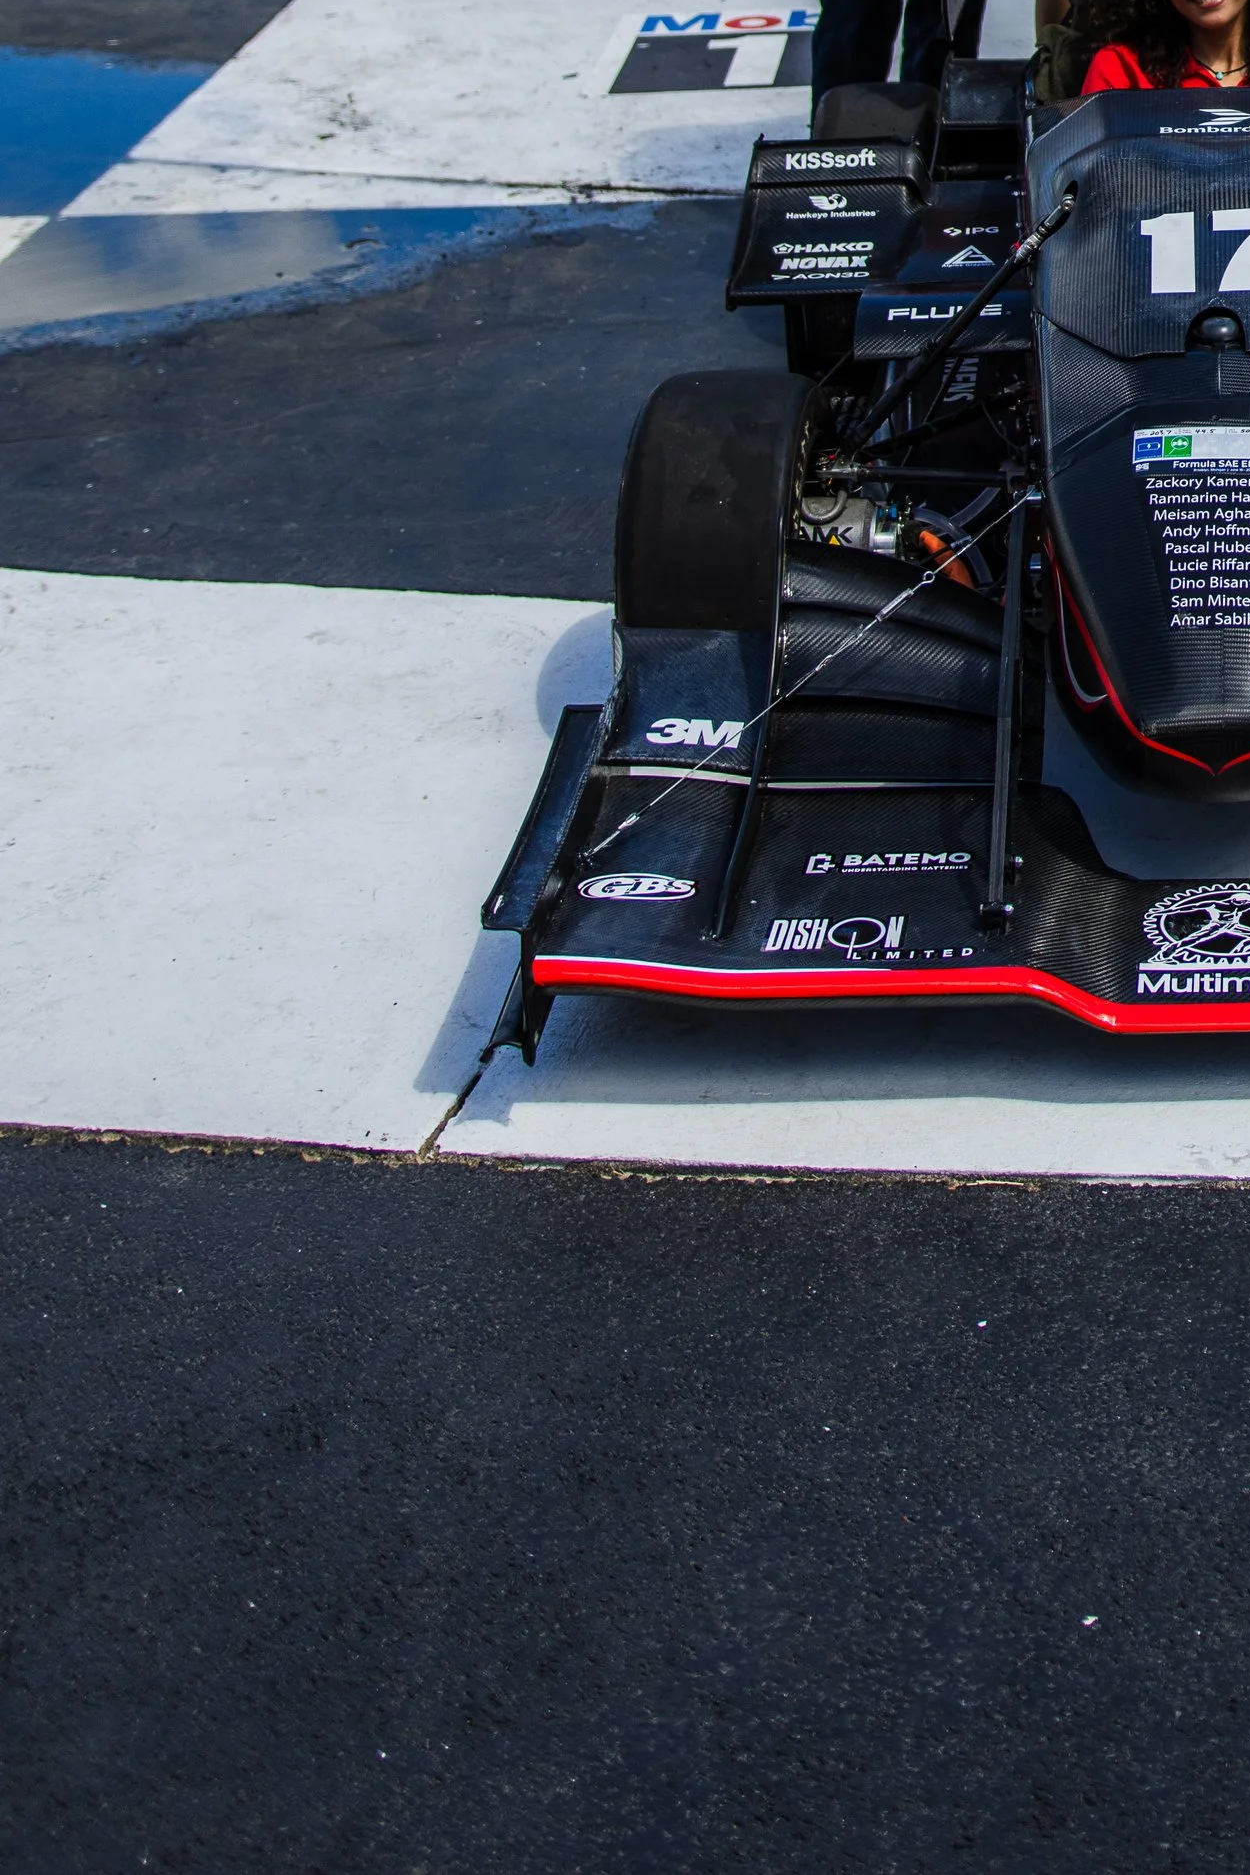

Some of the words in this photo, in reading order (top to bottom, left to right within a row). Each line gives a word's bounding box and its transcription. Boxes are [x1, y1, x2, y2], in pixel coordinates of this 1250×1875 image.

[640, 10, 822, 33] Mob
[785, 148, 876, 170] KISSsoft
[786, 211, 828, 219] Hawkeye
[830, 210, 876, 218] Industries
[965, 226, 999, 235] IPG
[794, 242, 875, 253] HAKKO
[780, 256, 868, 270] NOVAX
[888, 303, 1003, 321] FLUE
[1173, 461, 1216, 469] Formula
[1146, 478, 1203, 489] Zackory
[1150, 493, 1227, 504] Ramnarine
[1154, 509, 1210, 521] Meisam
[1163, 526, 1201, 538] Andy
[1166, 542, 1209, 554] Pascal
[1170, 559, 1208, 571] Lucie
[1171, 577, 1205, 589] Dino
[1172, 596, 1203, 607] Sam
[1171, 614, 1210, 627] Amar
[646, 718, 744, 748] 3M
[844, 853, 971, 866] BATEMO
[852, 948, 973, 959] LIMITED
